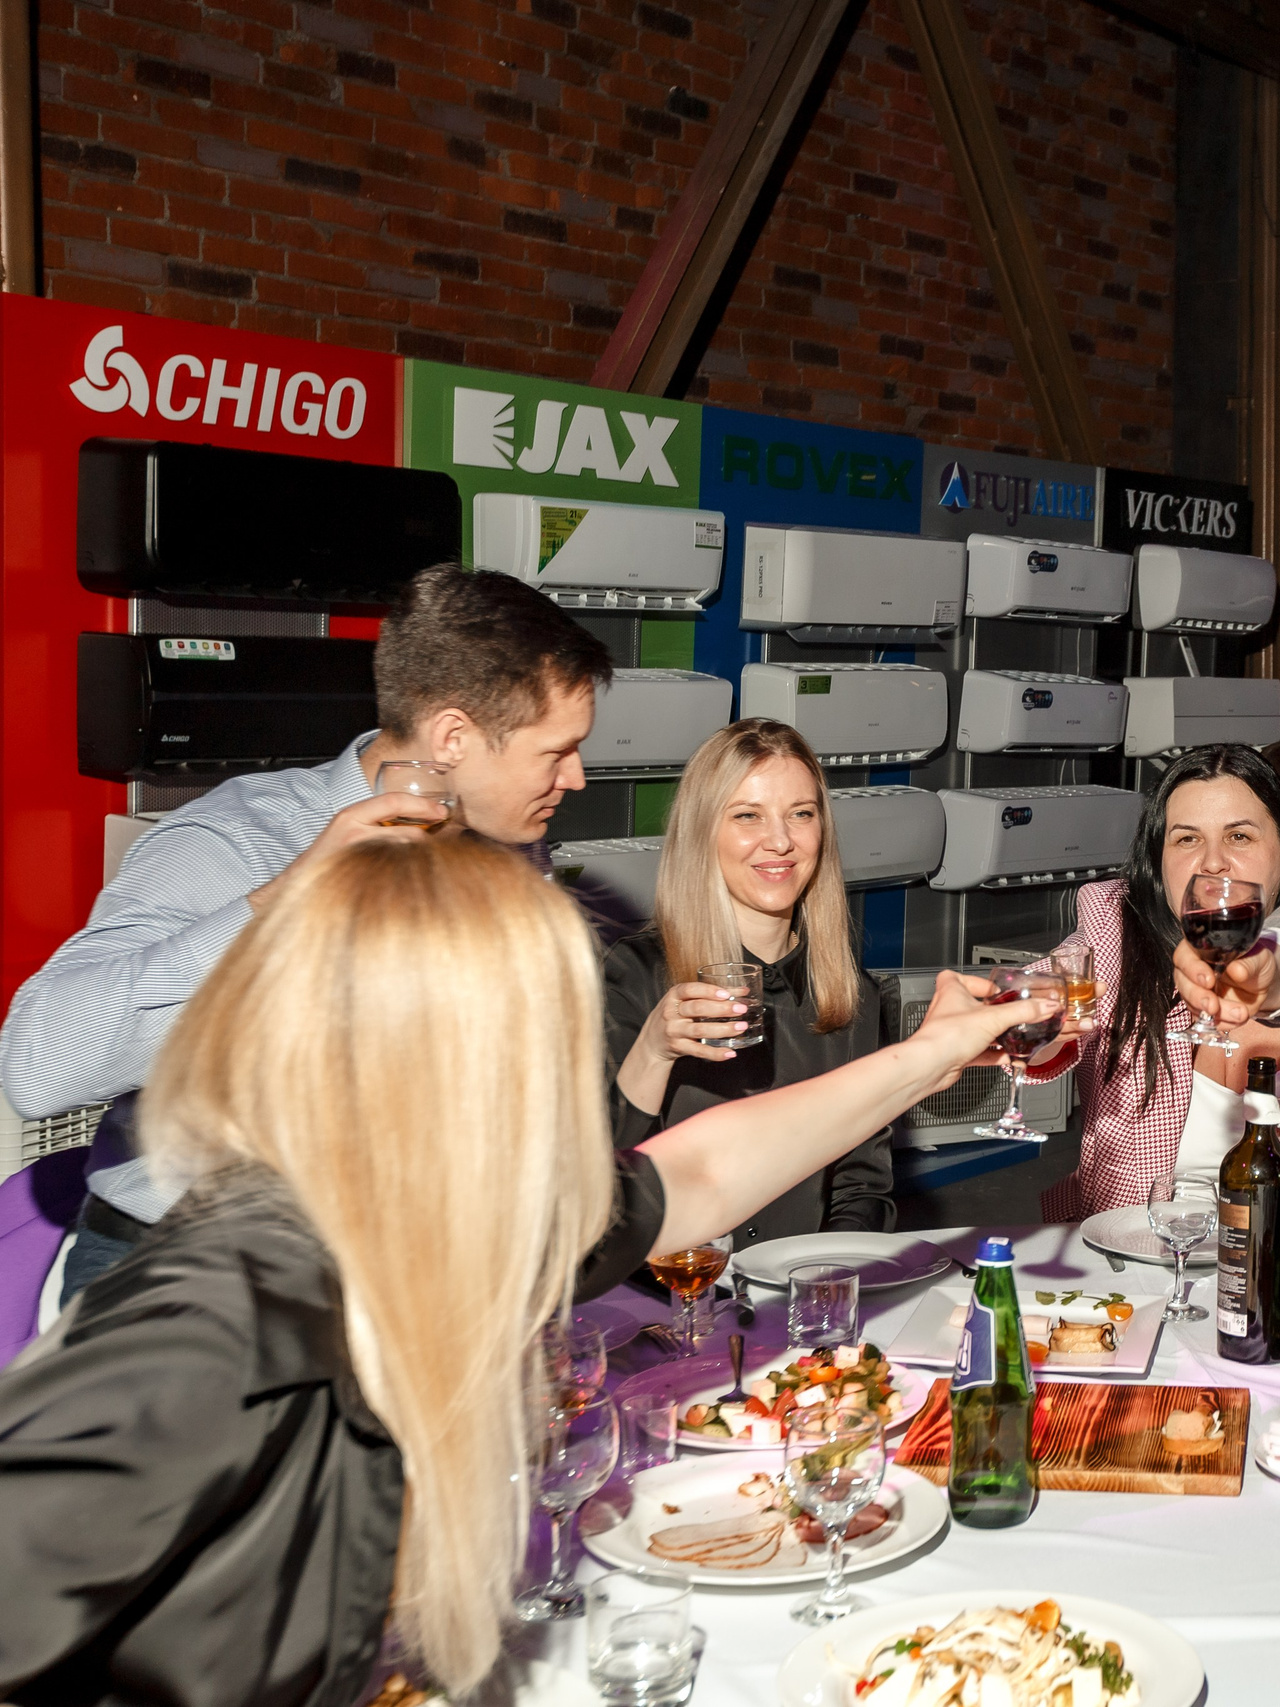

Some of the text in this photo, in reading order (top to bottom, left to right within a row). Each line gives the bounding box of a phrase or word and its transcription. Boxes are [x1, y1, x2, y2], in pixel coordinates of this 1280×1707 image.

[155, 353, 367, 440] CHIGO
[516, 399, 680, 488] JAX
[722, 434, 915, 503] ROVEX
[1125, 488, 1238, 539] VICKERS
